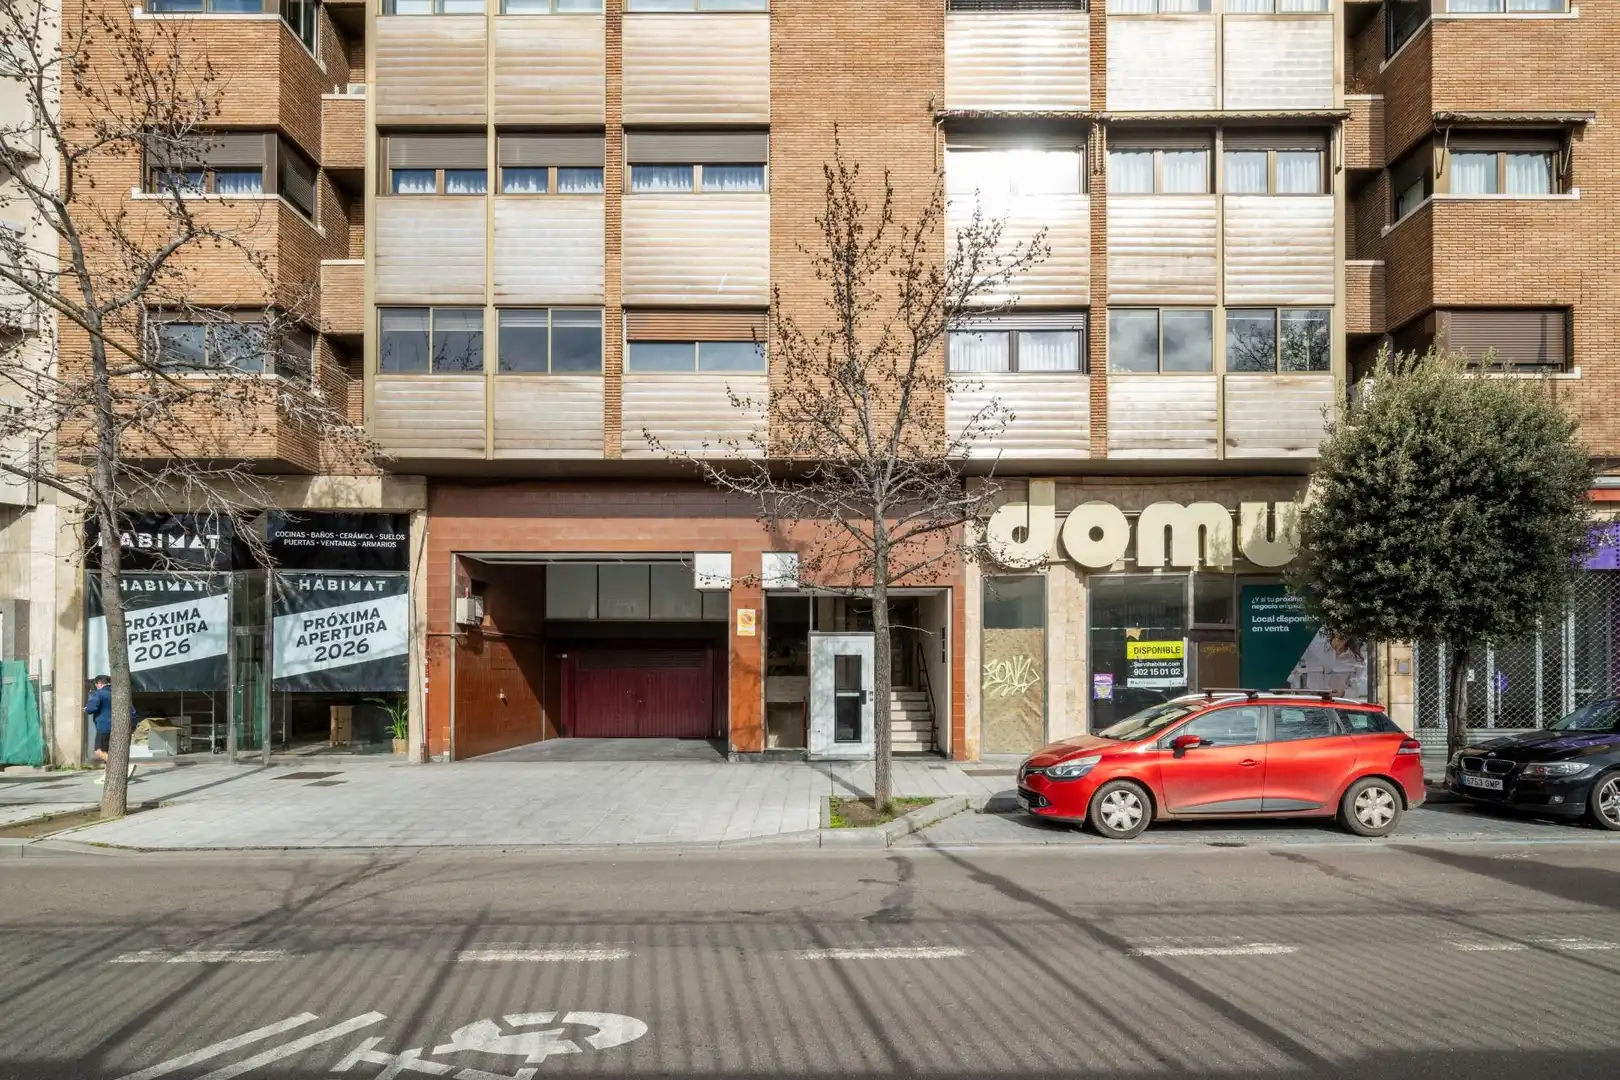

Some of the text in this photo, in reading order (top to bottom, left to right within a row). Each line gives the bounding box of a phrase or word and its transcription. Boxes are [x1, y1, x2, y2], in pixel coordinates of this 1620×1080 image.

[987, 478, 1301, 568] domu
[310, 531, 335, 539] BAÑOS
[339, 532, 374, 540] CERÁMICA
[379, 533, 406, 541] SUELOS
[299, 579, 386, 591] HABIMAT
[303, 607, 381, 632] PRÓXIMA
[128, 620, 209, 645] PERTURA
[296, 620, 388, 648] APERTURA
[134, 638, 191, 663] 2026
[314, 638, 370, 663] 2026
[1133, 646, 1181, 655] DISPONIBLE
[1133, 668, 1149, 676] 902
[1150, 668, 1159, 676] 15
[1160, 668, 1169, 676] 01
